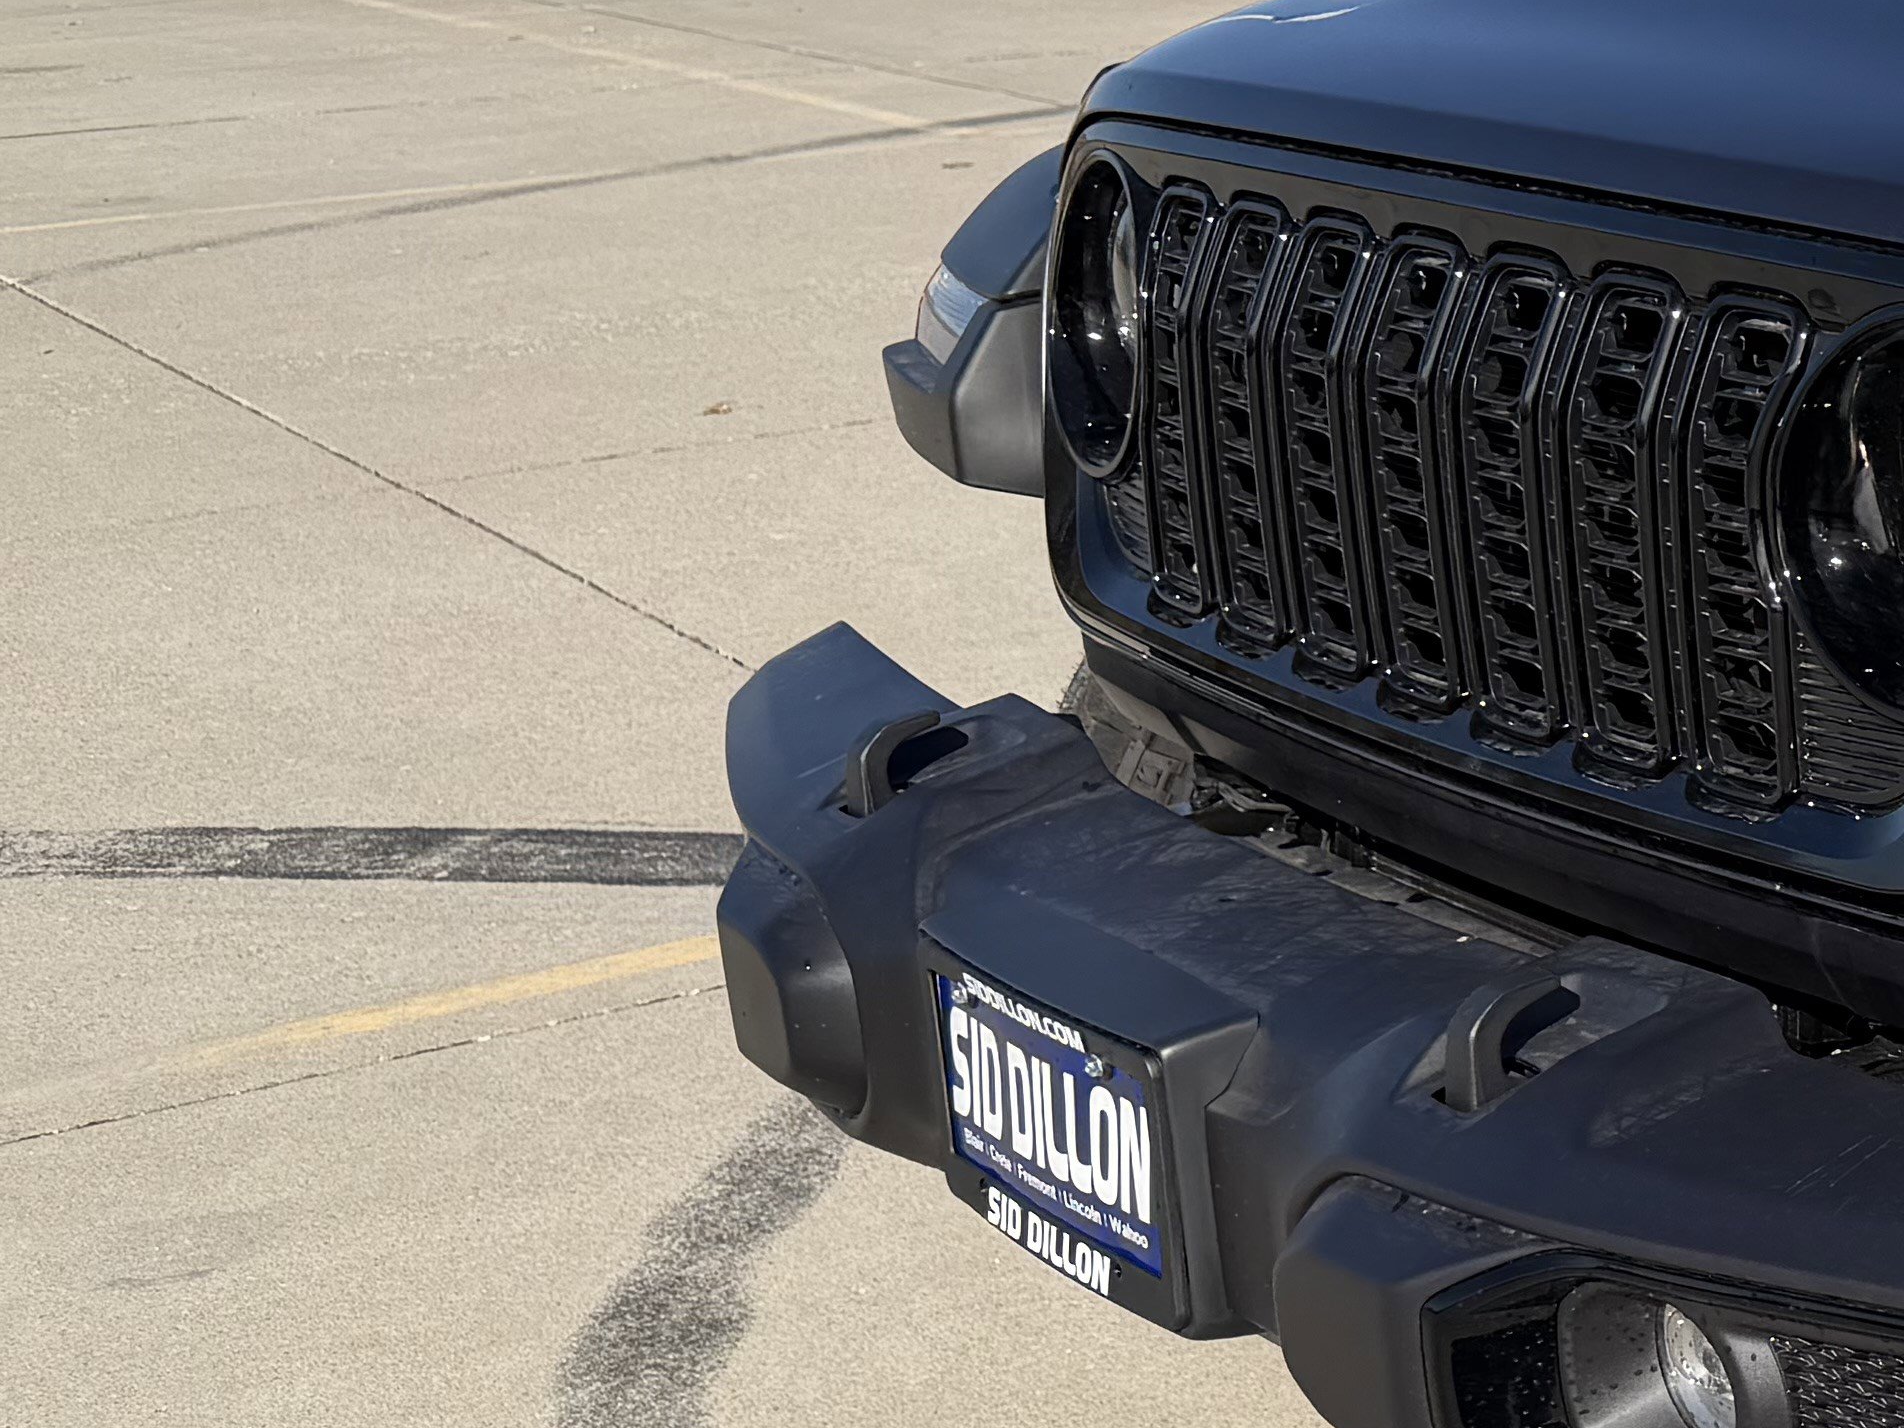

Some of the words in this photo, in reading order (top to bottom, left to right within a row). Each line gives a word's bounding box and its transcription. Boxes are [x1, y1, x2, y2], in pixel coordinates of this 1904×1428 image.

[962, 972, 1086, 1054] SIDDILLON.COM
[950, 1005, 1003, 1141] SID
[1006, 1040, 1152, 1225] DILLON
[986, 1185, 1023, 1241] SID
[1026, 1210, 1111, 1297] DILLON
[1062, 1189, 1104, 1227] Lincoln
[1108, 1213, 1150, 1250] Wahoo
